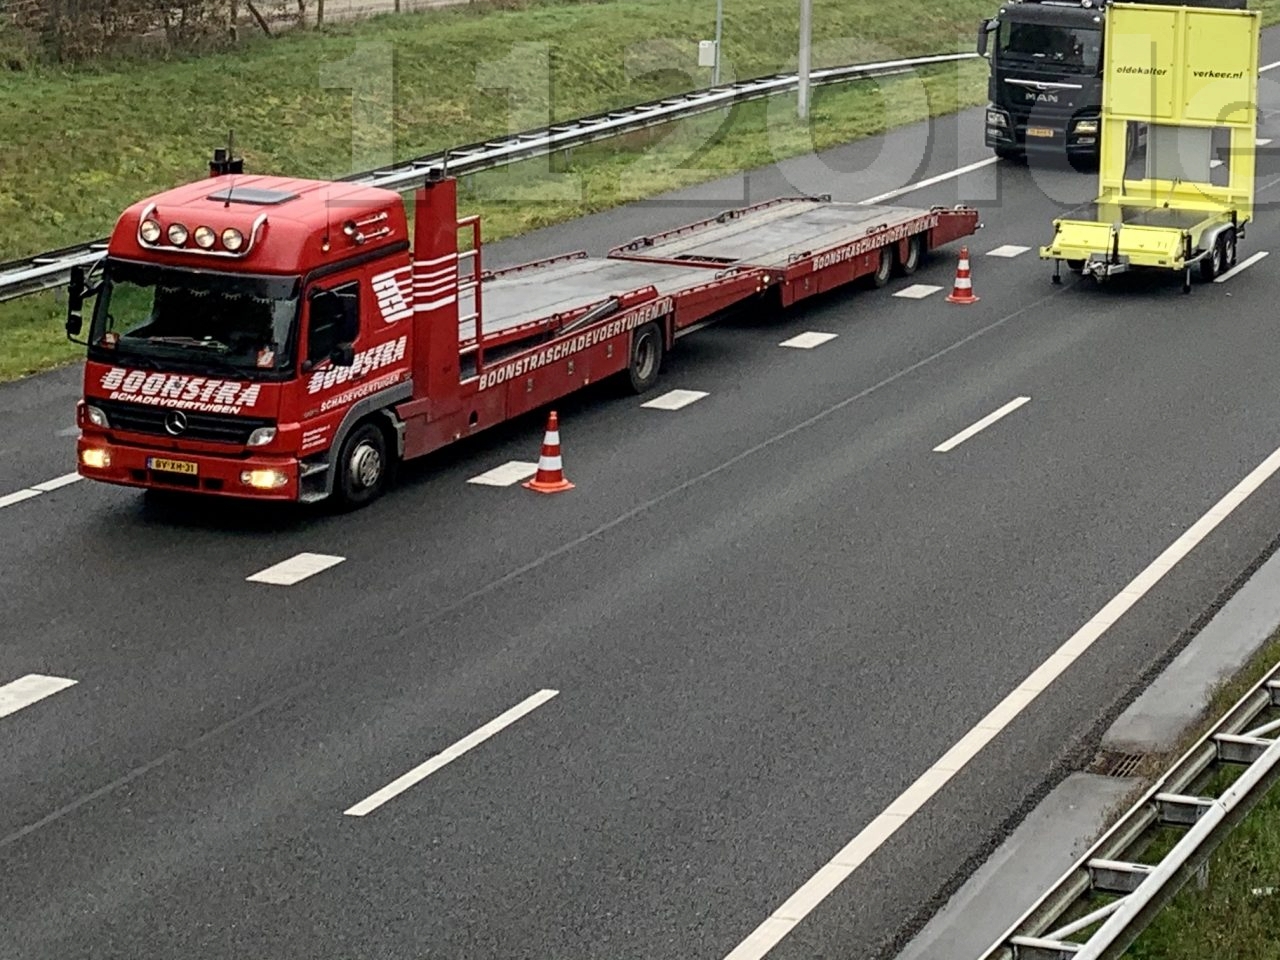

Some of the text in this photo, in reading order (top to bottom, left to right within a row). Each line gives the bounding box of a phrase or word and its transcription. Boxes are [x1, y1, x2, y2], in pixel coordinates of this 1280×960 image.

[1193, 70, 1243, 79] verkeer.nl
[1025, 93, 1058, 103] MAN
[479, 296, 674, 391] BOONSTRASCHADEVOERTUIGEN.NL
[101, 367, 261, 407] BOONSTRA
[109, 391, 241, 415] SCHADEVOERTUIGEN
[320, 372, 400, 412] SCHADEVOERTUIGEN
